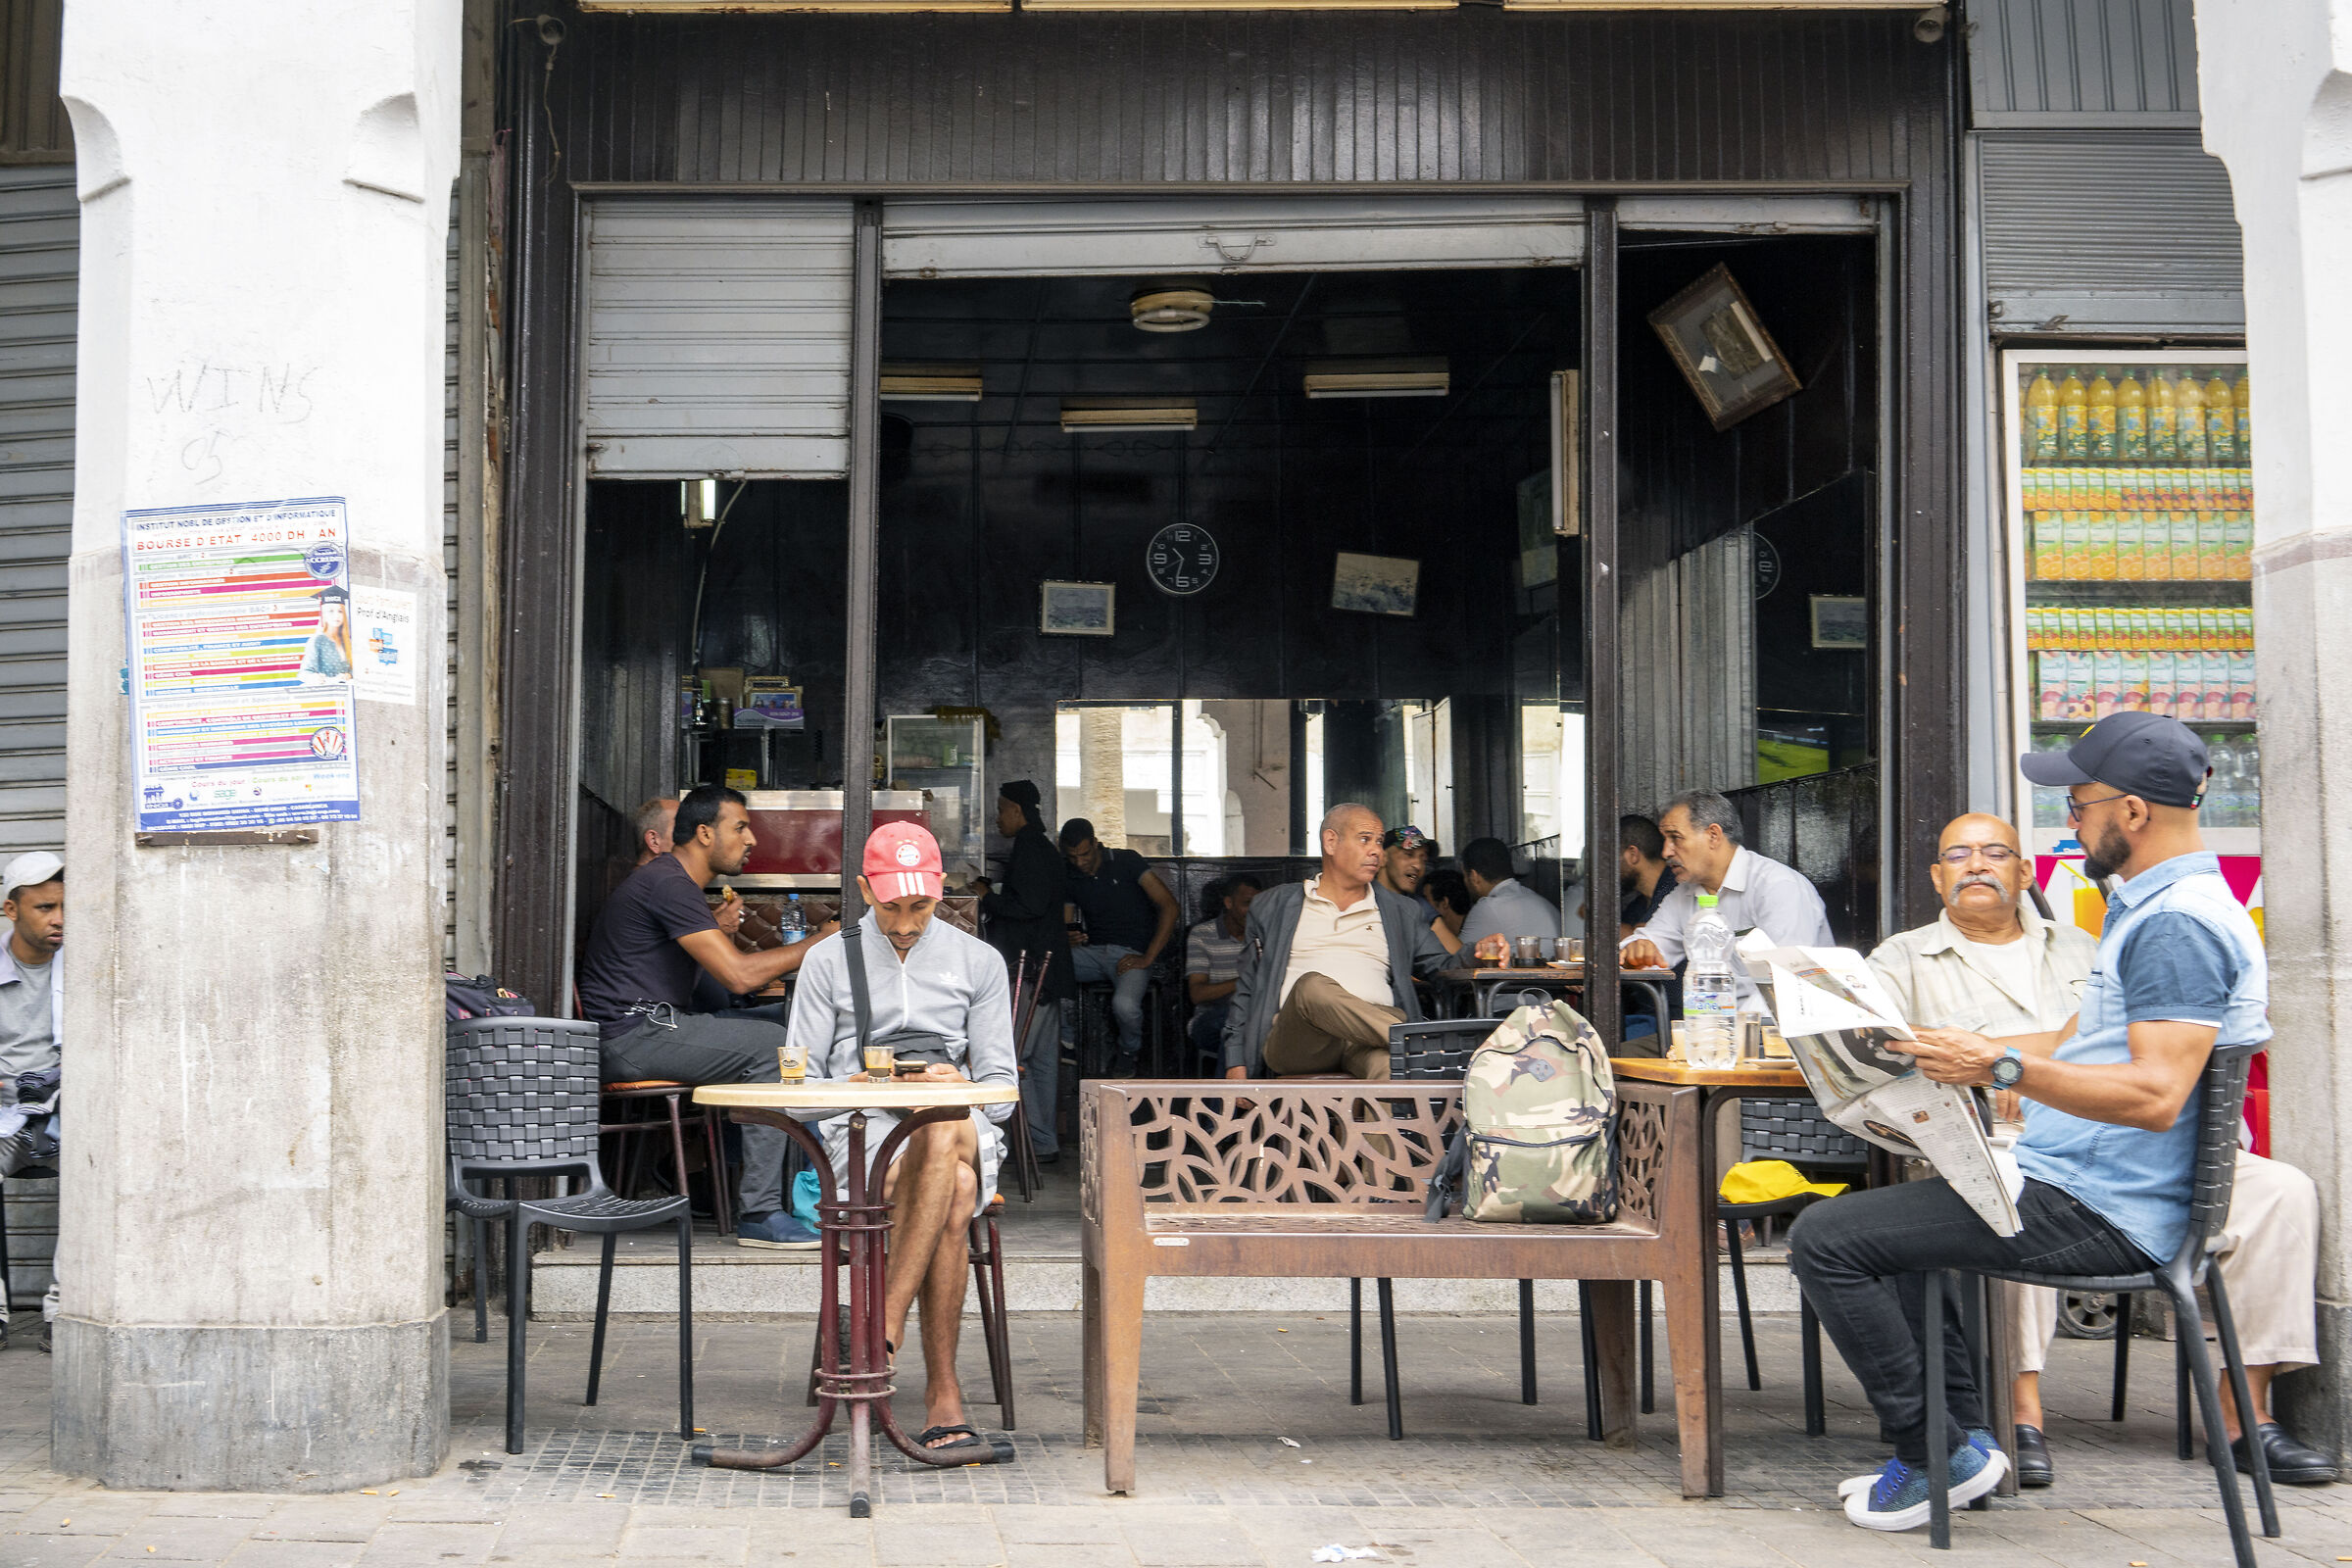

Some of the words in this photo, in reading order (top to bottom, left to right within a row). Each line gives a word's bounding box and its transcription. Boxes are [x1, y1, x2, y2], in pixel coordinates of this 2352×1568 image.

[135, 519, 174, 530] INSTITUT
[201, 516, 213, 526] DE
[215, 514, 251, 525] GESTION
[136, 537, 191, 550] BOURSE
[195, 534, 241, 546] D'ETAT
[250, 531, 282, 543] 4000
[286, 529, 305, 540] DH
[318, 527, 336, 538] AN
[1175, 530, 1191, 542] 12
[1153, 553, 1167, 564] 9
[1199, 554, 1212, 565] 3
[1176, 576, 1190, 588] 6
[356, 607, 373, 619] Prof
[375, 610, 410, 623] d'Anglais
